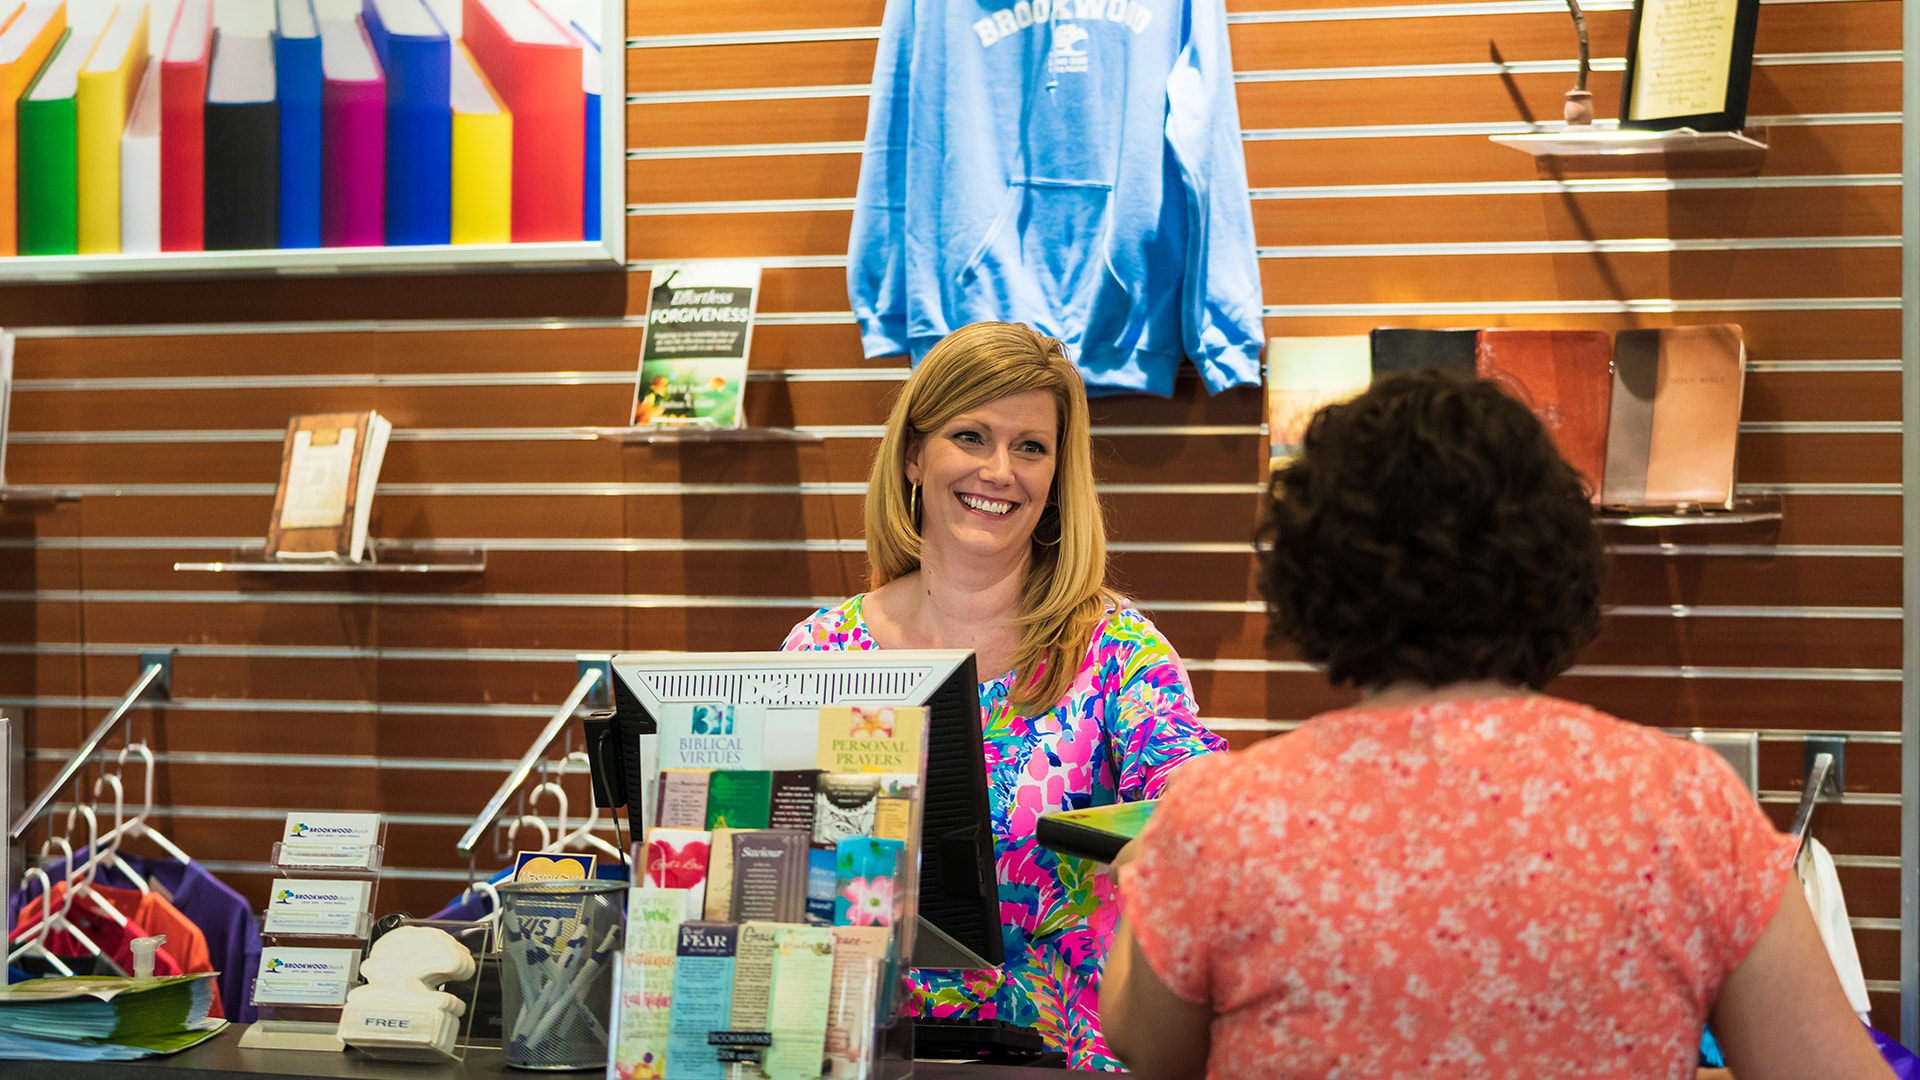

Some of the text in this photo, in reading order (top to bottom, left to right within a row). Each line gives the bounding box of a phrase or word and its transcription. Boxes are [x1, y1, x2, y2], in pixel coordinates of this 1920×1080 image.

[670, 289, 734, 306] Effortless
[650, 307, 749, 325] FORGIVENESS
[679, 737, 743, 751] BIBLICAL
[832, 739, 909, 753] PERSONAL
[679, 751, 741, 764] VIRTUES
[836, 753, 902, 766] PRAYERS
[741, 846, 784, 858] Saviour
[682, 934, 727, 948] FEAR
[365, 1017, 409, 1029] FREE
[710, 1033, 770, 1044] BOOKMARKS
